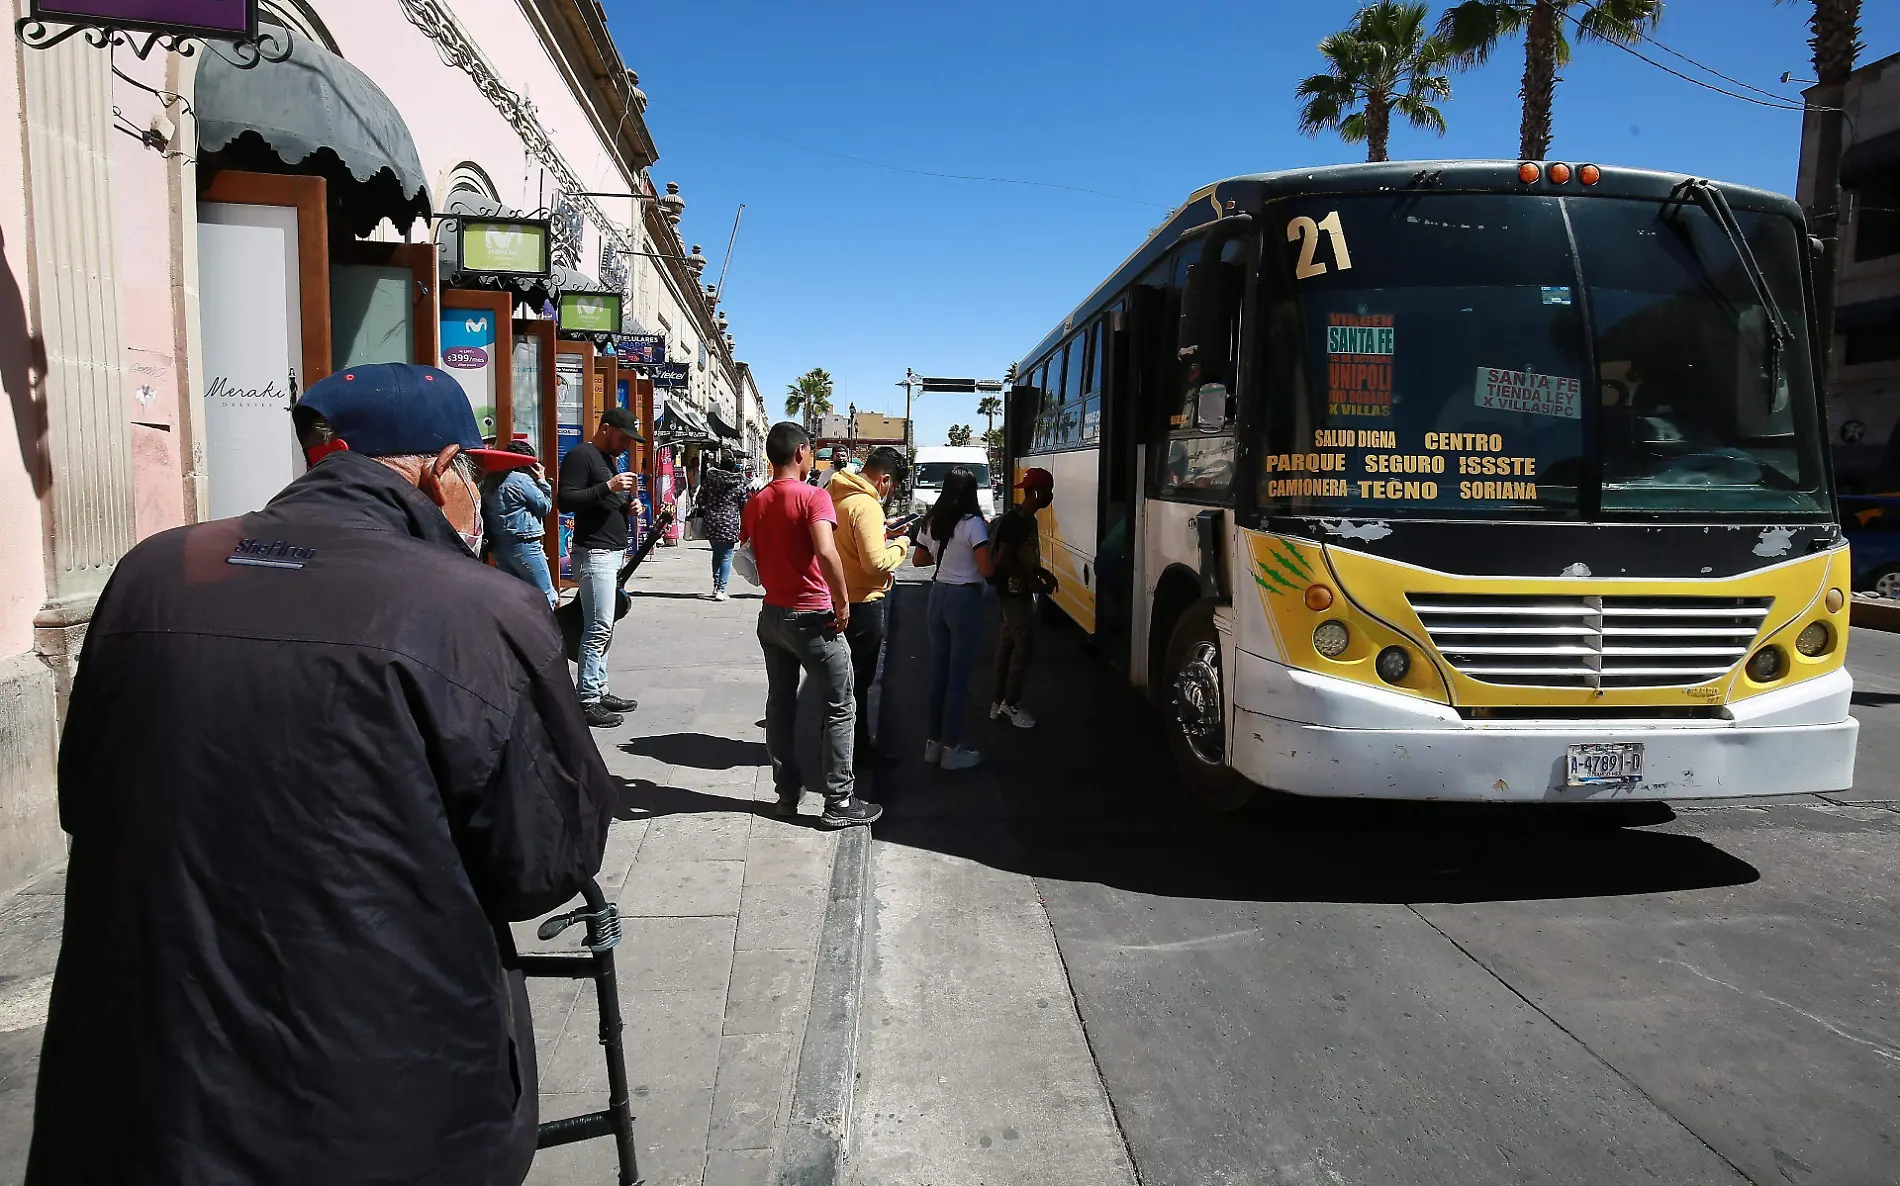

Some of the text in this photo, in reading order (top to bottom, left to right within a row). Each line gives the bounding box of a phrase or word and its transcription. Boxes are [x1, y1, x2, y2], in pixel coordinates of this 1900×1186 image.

[1287, 210, 1352, 279] 21
[1329, 313, 1394, 326] VIRGEN
[1329, 327, 1393, 353] SANTA FE
[660, 371, 686, 380] telcel
[1328, 363, 1392, 391] UNIPOLI
[1487, 369, 1579, 394] SANTA FE
[204, 377, 286, 398] Meraki
[1487, 383, 1575, 406] TIENDA LEY
[1328, 403, 1392, 417] X VILLAS
[1483, 396, 1574, 417] X VILLAS/PC
[1315, 429, 1503, 452] SALUD DIGNA CENTRO
[1266, 453, 1536, 476] PARQUE SEGURO ISSSTE
[1268, 478, 1537, 500] CAMIONERA TECNO SORIANA
